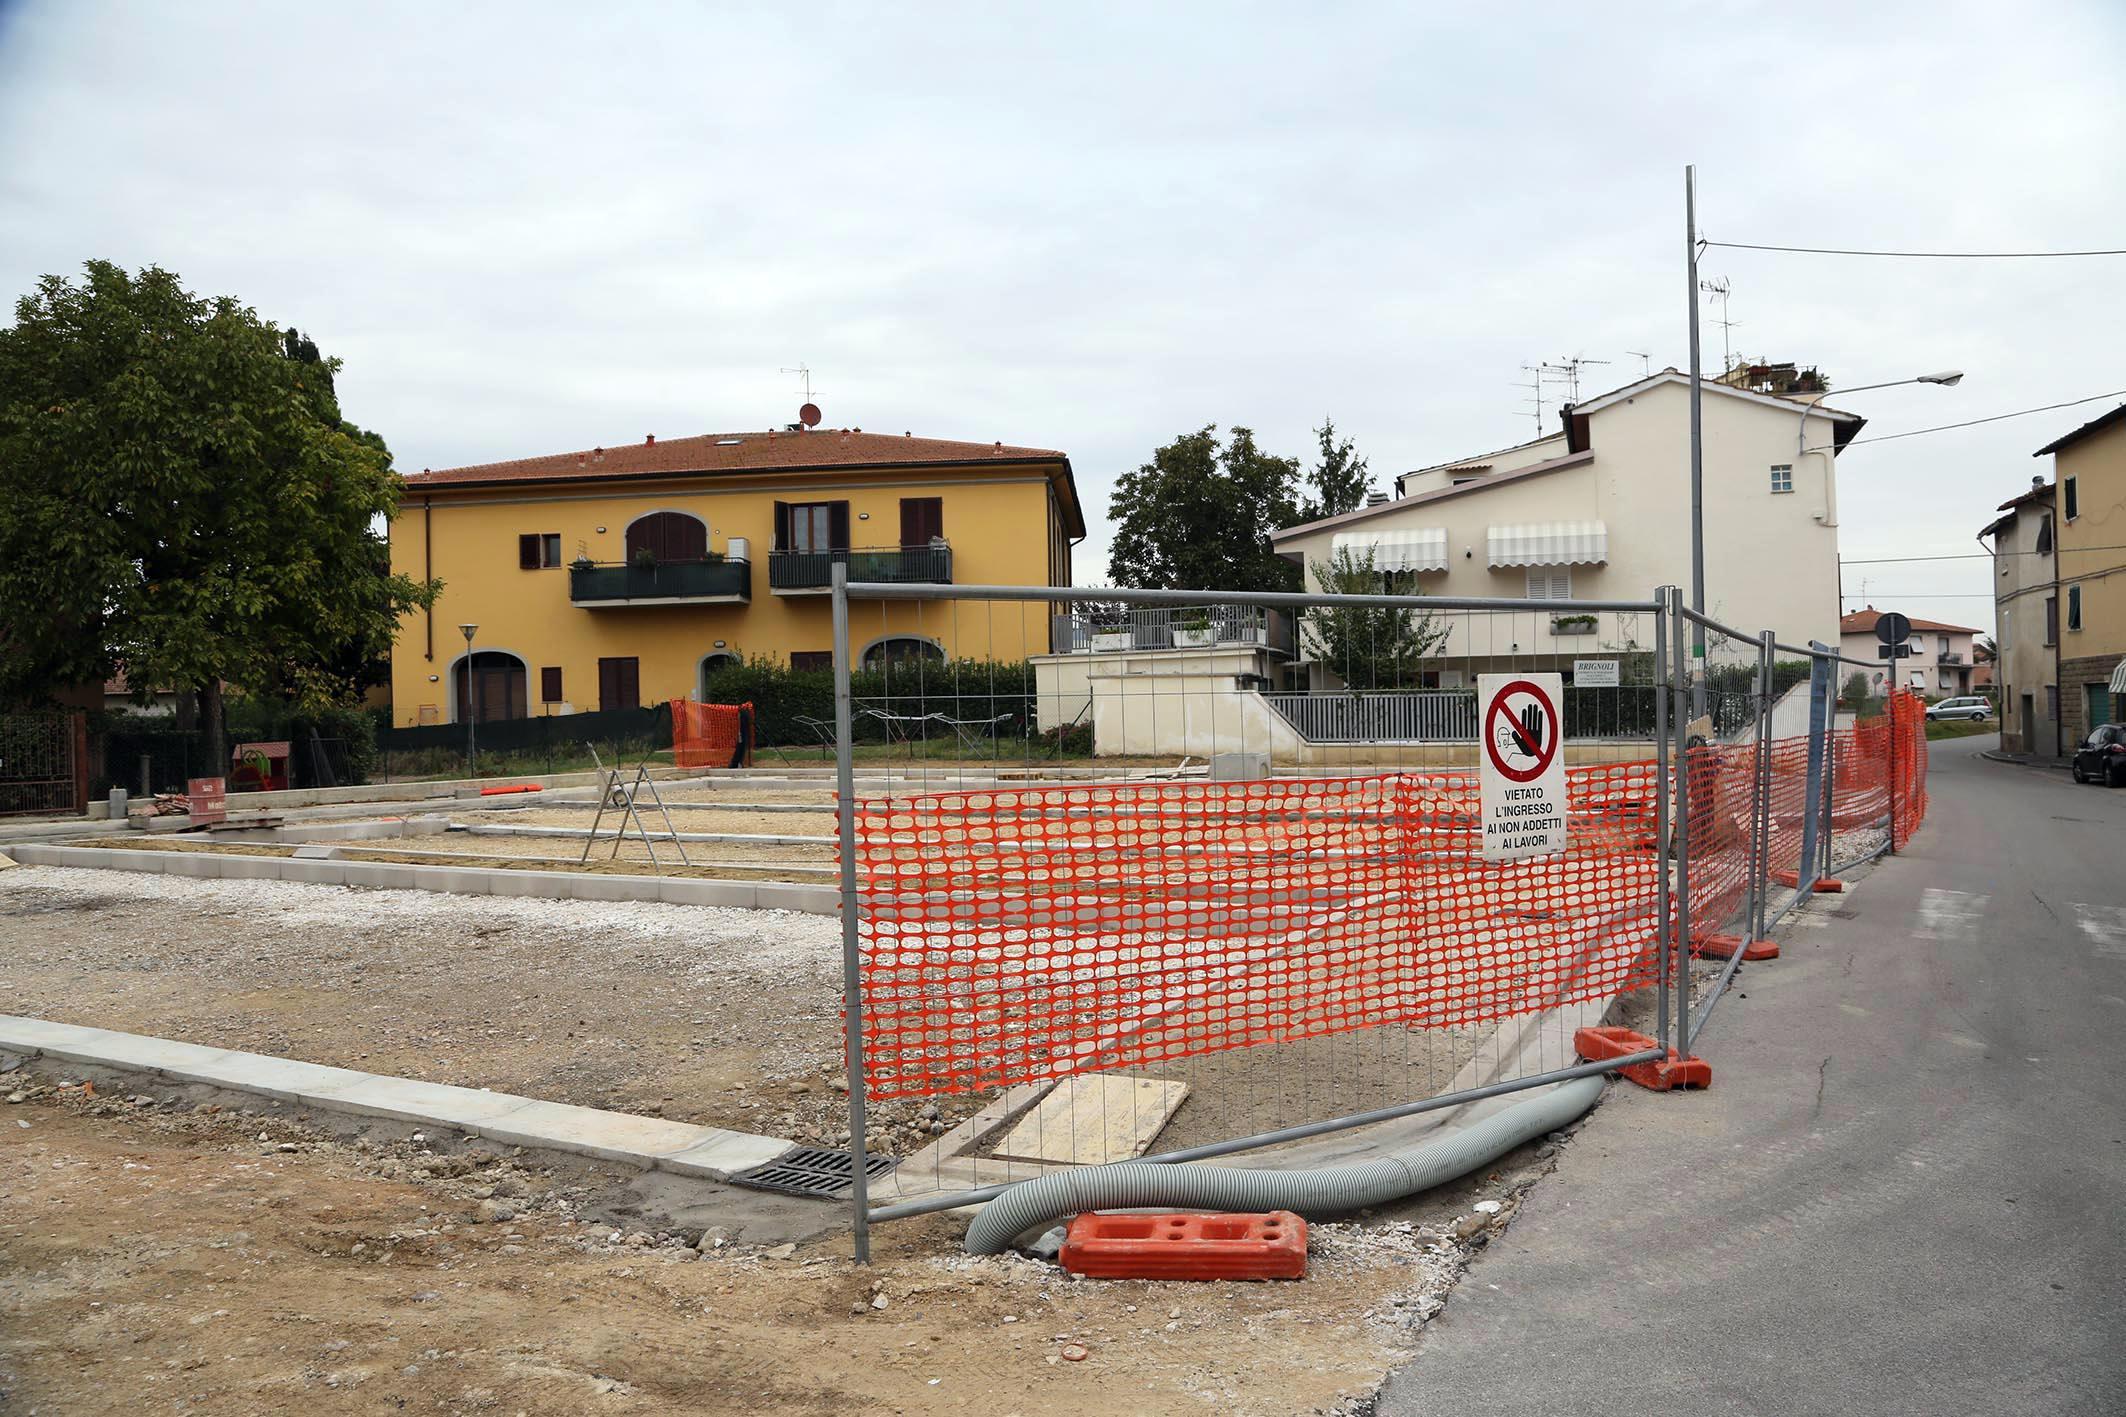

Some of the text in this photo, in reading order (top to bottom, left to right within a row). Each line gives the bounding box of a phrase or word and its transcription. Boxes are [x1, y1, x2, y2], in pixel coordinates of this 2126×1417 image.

[1578, 662, 1615, 671] BRIGNOLI
[1504, 787, 1544, 801] VIETATO
[1495, 802, 1553, 818] L'INGRESSO
[1487, 818, 1562, 835] AI NON ADDETTI
[1502, 834, 1548, 850] AI LAVORI
